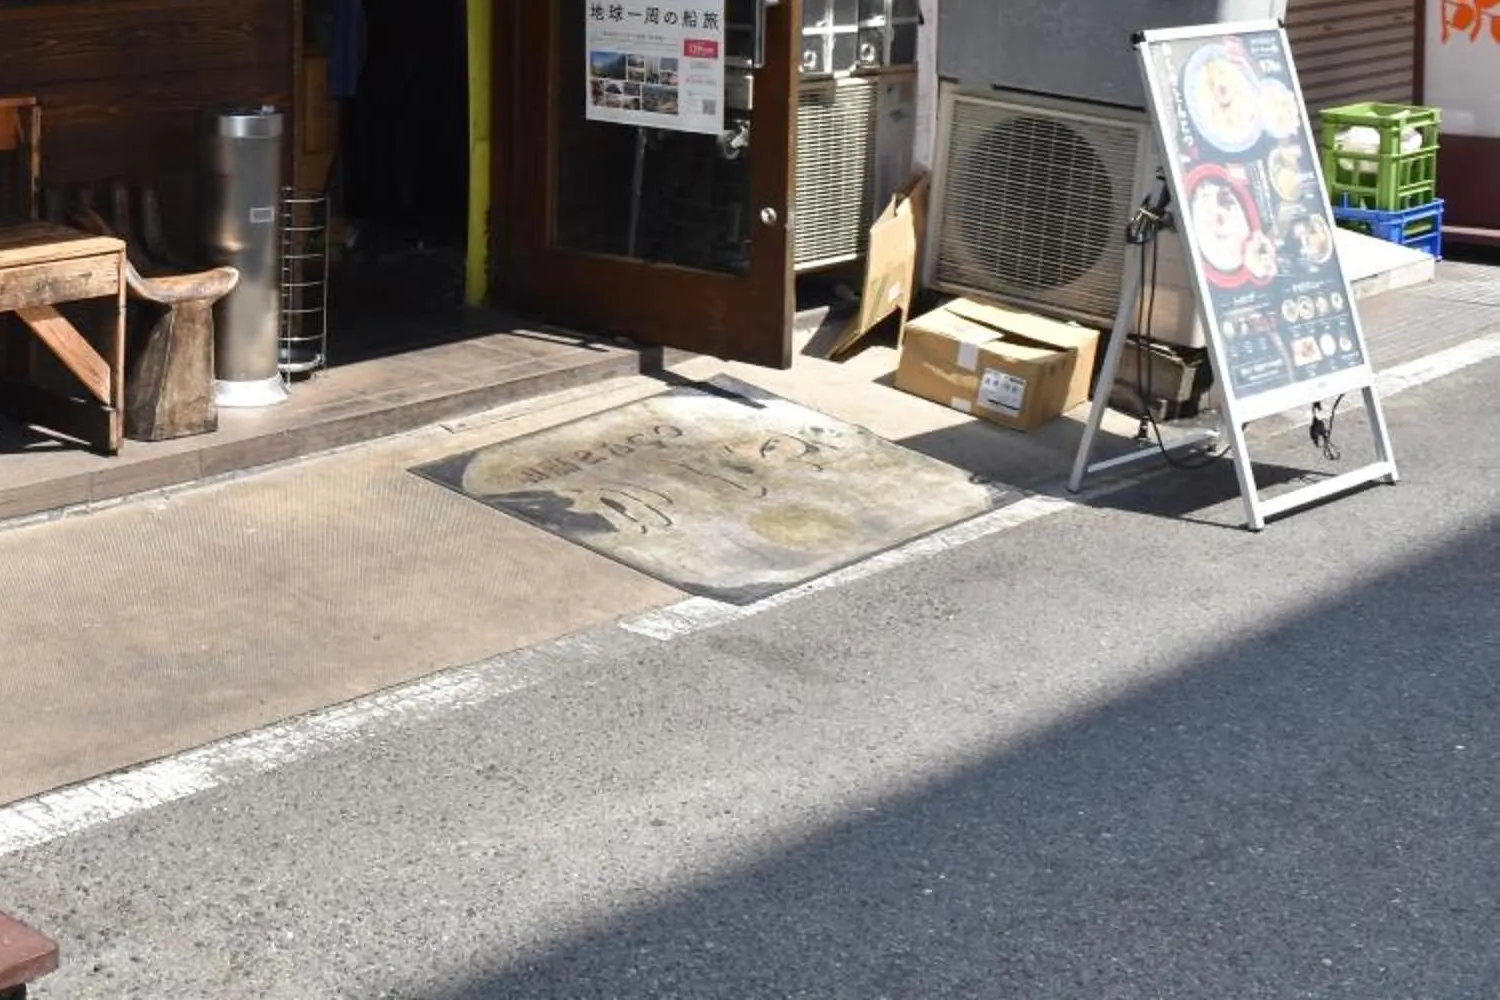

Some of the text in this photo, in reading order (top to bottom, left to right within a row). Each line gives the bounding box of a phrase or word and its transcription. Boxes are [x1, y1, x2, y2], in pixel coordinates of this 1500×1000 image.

[589, 2, 720, 31] 地球一周の船旅
